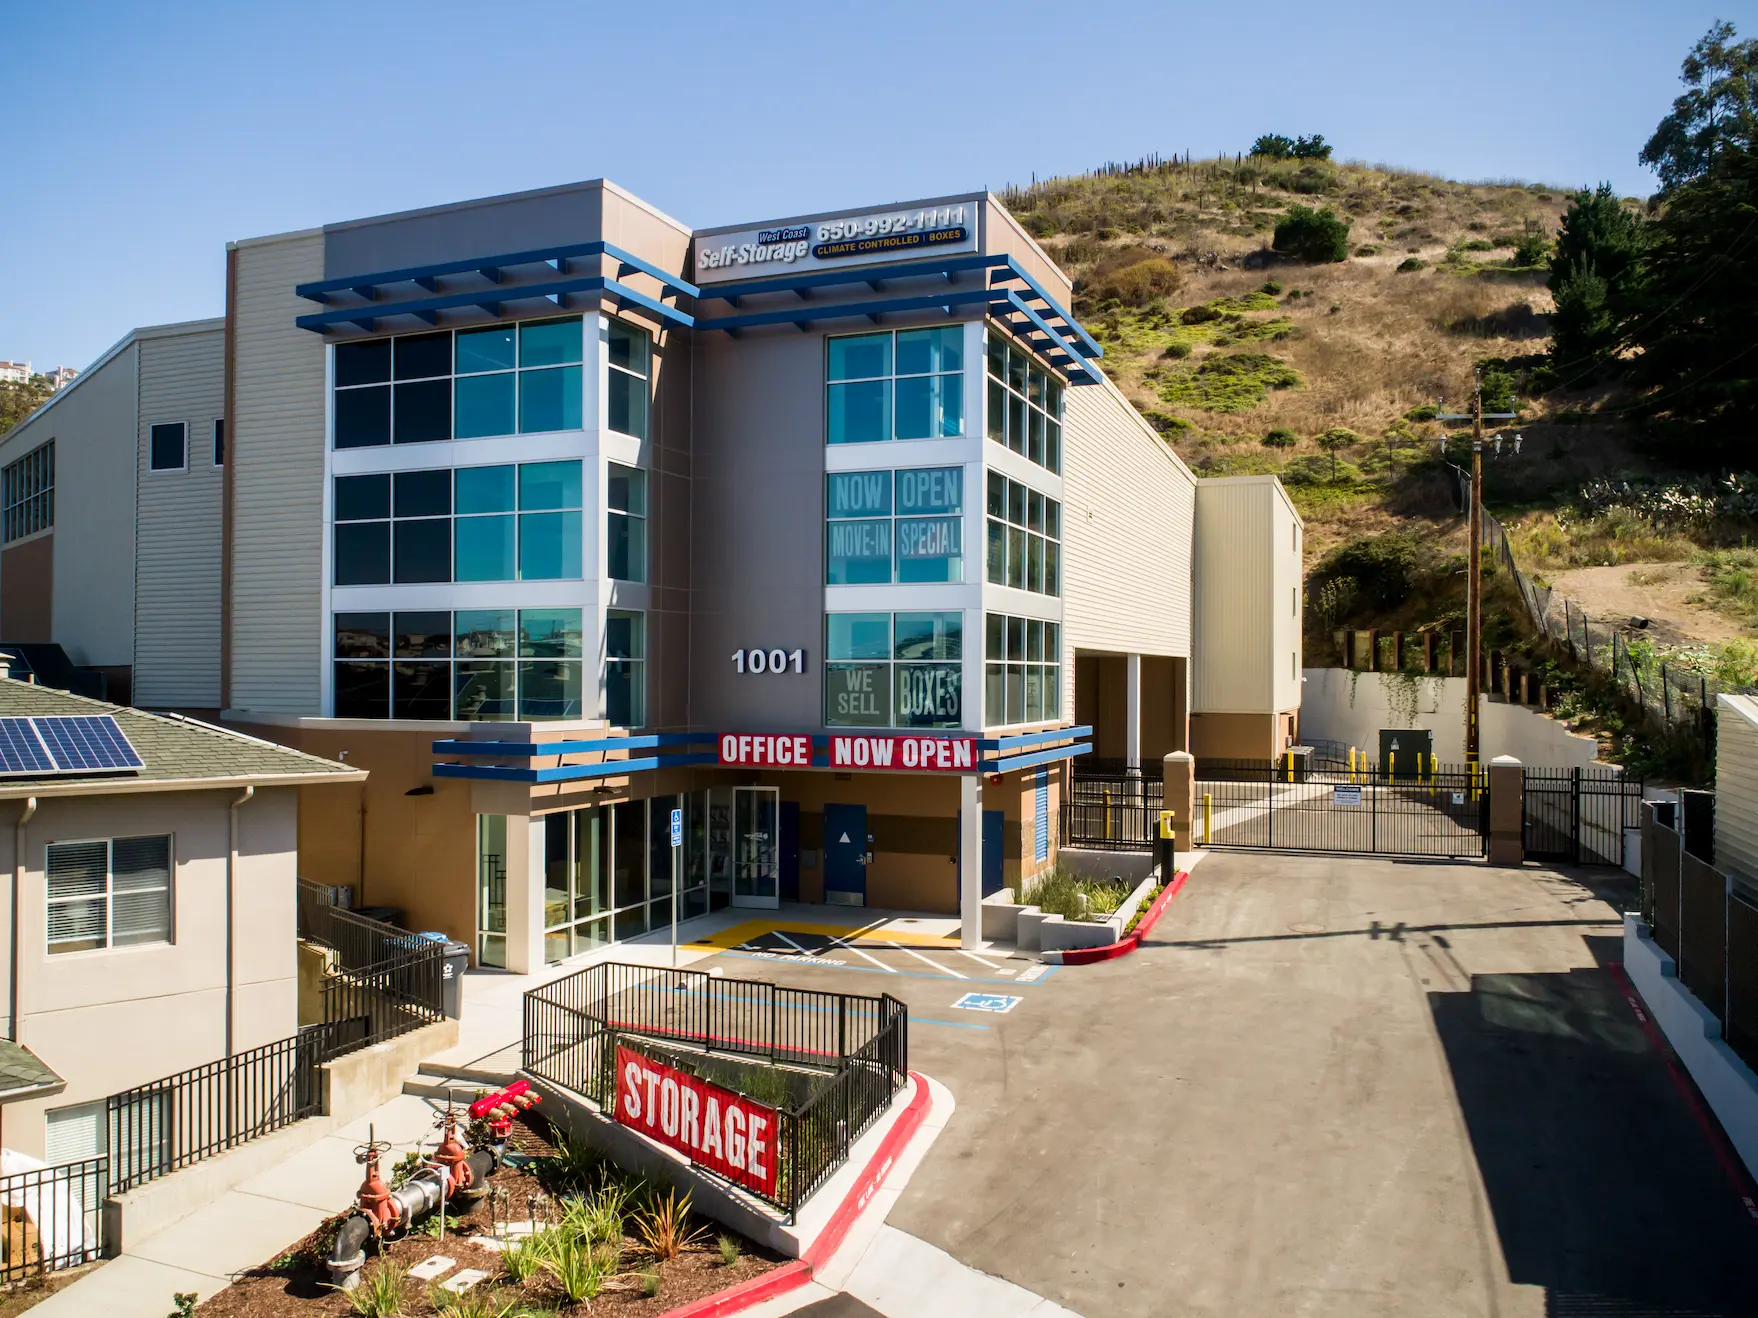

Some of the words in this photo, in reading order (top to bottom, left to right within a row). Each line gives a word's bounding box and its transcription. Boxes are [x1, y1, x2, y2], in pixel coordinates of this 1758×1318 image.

[759, 230, 781, 243] West
[782, 227, 807, 240] Coast
[816, 206, 965, 243] 650-992-1111
[698, 240, 809, 270] Self-Storage
[817, 242, 856, 256] CLIMATE
[858, 235, 920, 251] CONTROLLED
[929, 229, 961, 242] BOXES
[836, 475, 883, 510] NOW
[902, 470, 958, 508] OPEN
[832, 523, 889, 557] MOVE-IN
[901, 521, 958, 555] SPECIAL
[731, 648, 804, 674] 1001
[845, 669, 873, 692] WE
[900, 669, 960, 716] BOXES
[837, 692, 880, 715] SELL
[722, 734, 809, 765] OFFICE
[835, 737, 894, 765] NOW
[902, 738, 972, 768] OPEN
[624, 1061, 768, 1180] STORAGE
